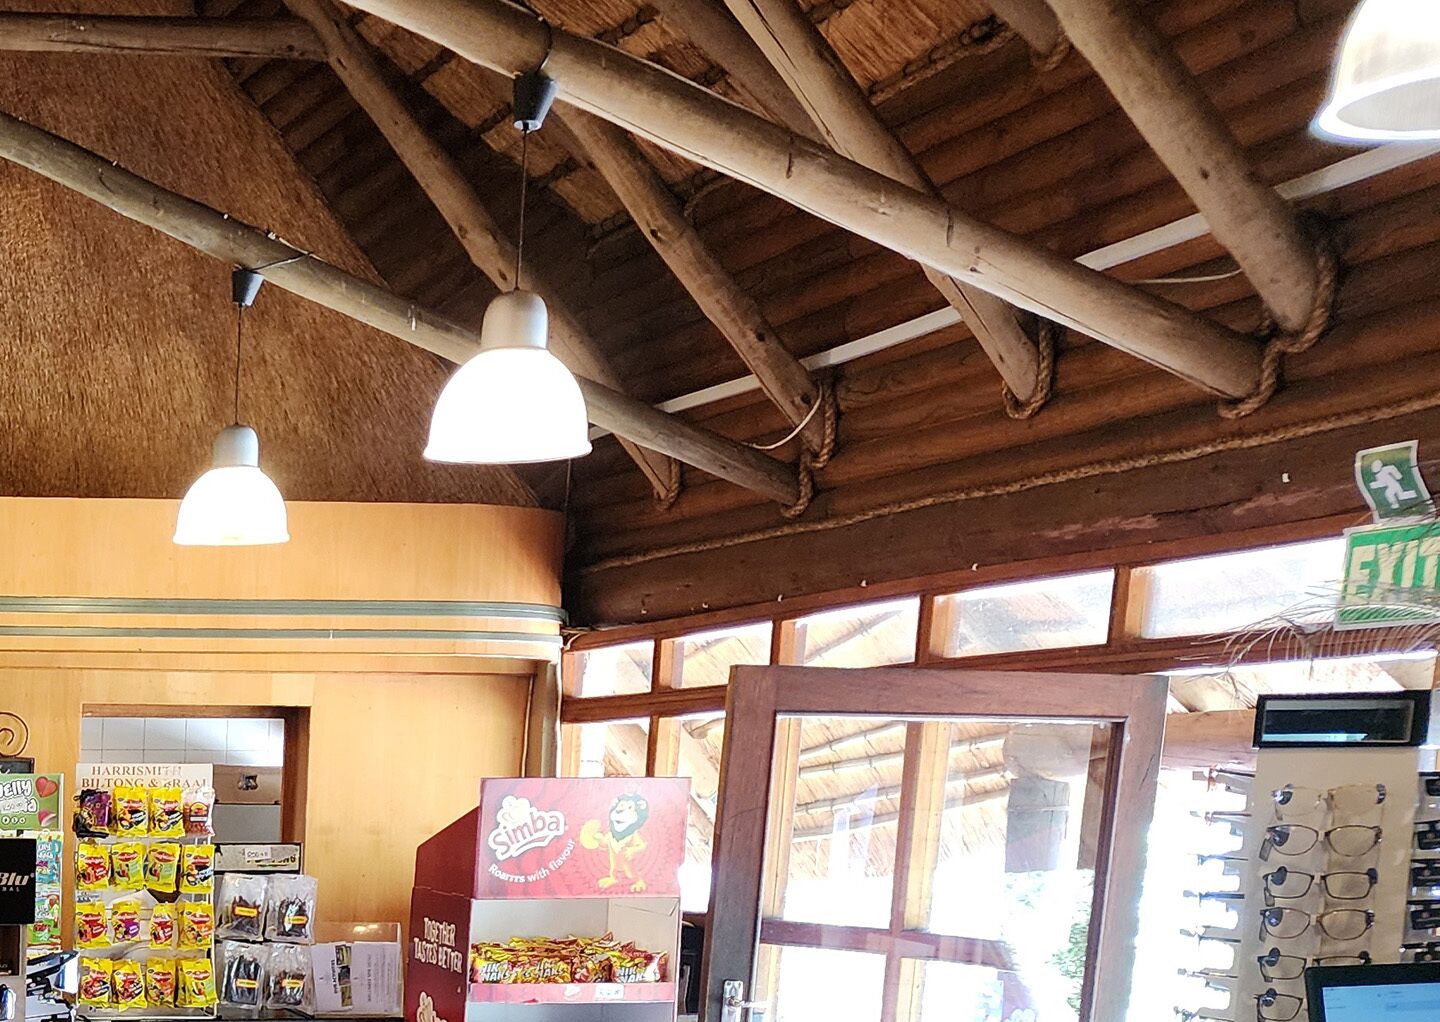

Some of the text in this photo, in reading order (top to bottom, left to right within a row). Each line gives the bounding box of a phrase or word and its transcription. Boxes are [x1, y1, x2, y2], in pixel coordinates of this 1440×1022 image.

[82, 779, 144, 788] BILTONG
[148, 779, 159, 788] &
[491, 810, 562, 858] Simba
[527, 867, 550, 882] with
[548, 838, 576, 871] flavour
[424, 917, 456, 947] TOGETHER
[414, 938, 462, 973] TASTES BETTER
